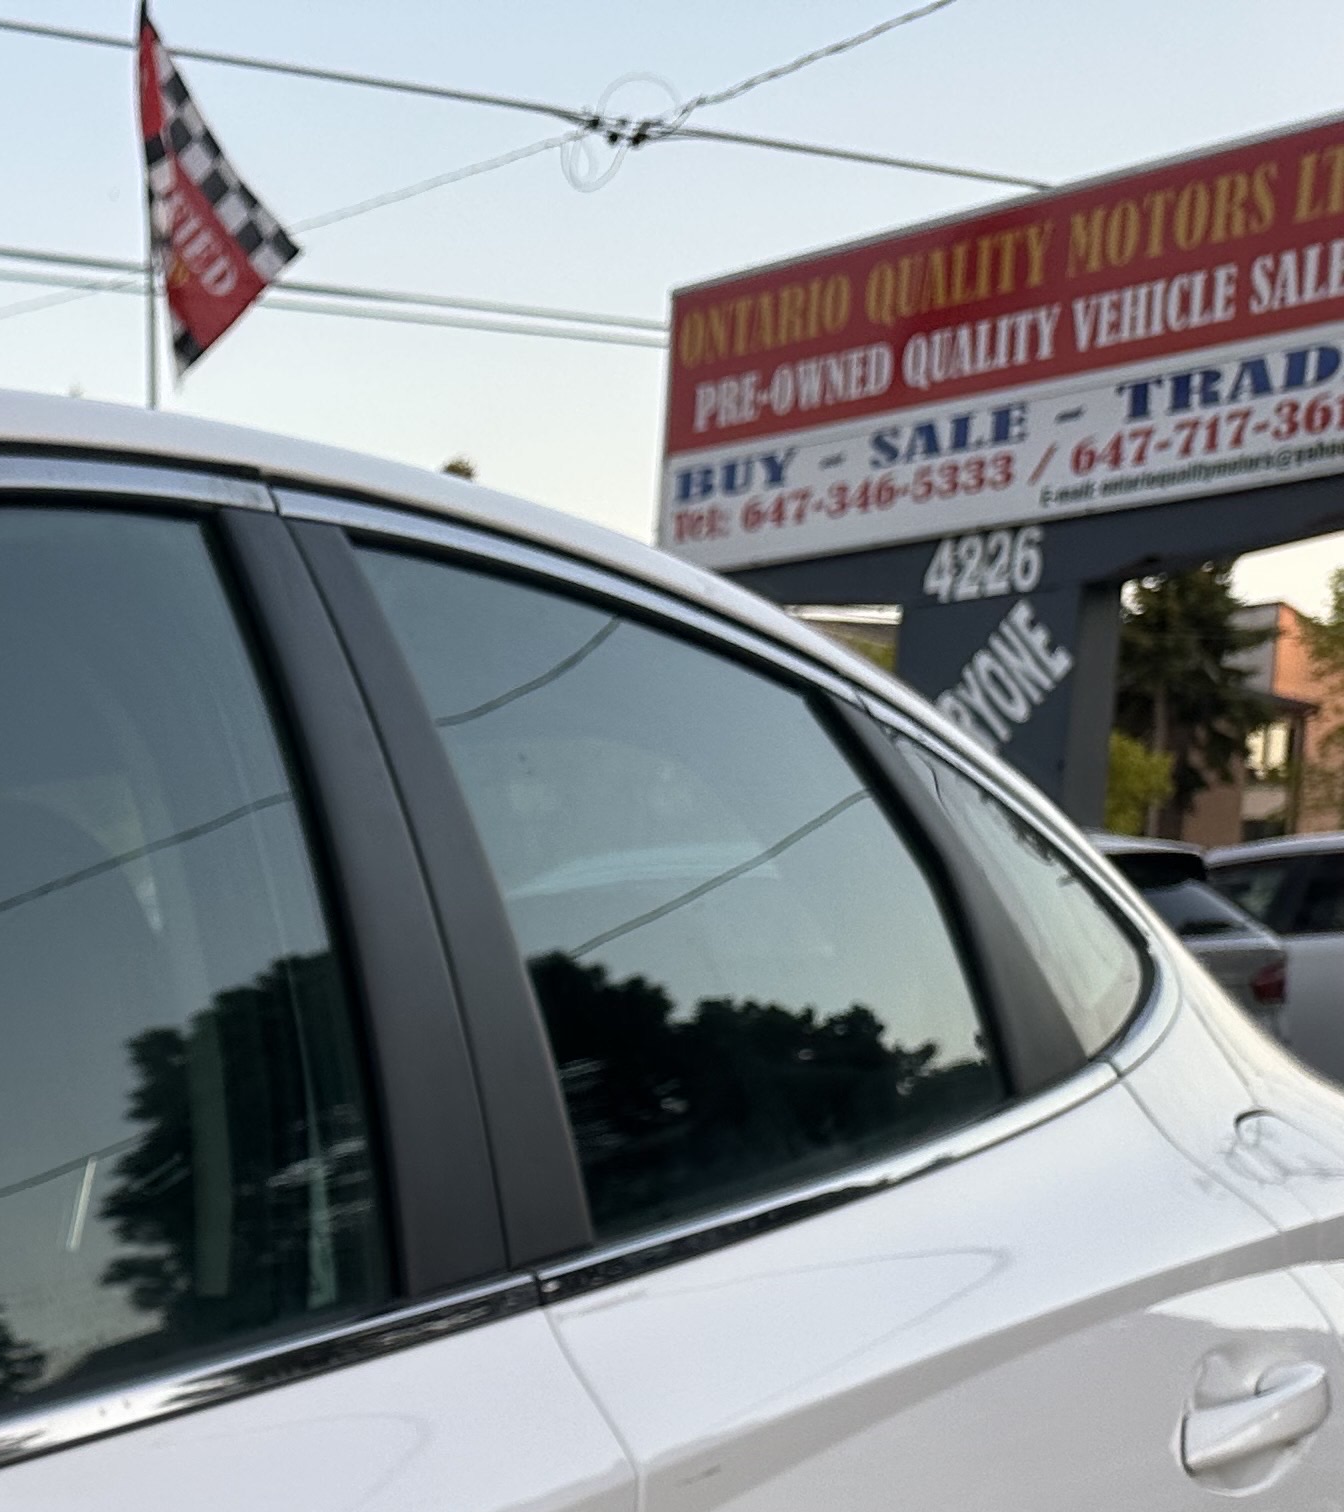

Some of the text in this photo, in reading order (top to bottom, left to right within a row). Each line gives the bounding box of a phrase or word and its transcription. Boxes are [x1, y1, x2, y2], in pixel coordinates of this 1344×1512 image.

[679, 270, 851, 369] ONTARIO
[864, 220, 1055, 327] QUALITY
[1066, 160, 1279, 278] MOTORS
[675, 447, 797, 504] BUY
[870, 401, 1028, 469] SALE
[1116, 344, 1344, 422] TRAD
[693, 341, 894, 434] PRE-OWNED
[902, 303, 1061, 391] QUALITY
[1072, 262, 1238, 353] VEHICLE
[740, 450, 1013, 532] 647-346-5333
[922, 526, 1046, 602] 4226
